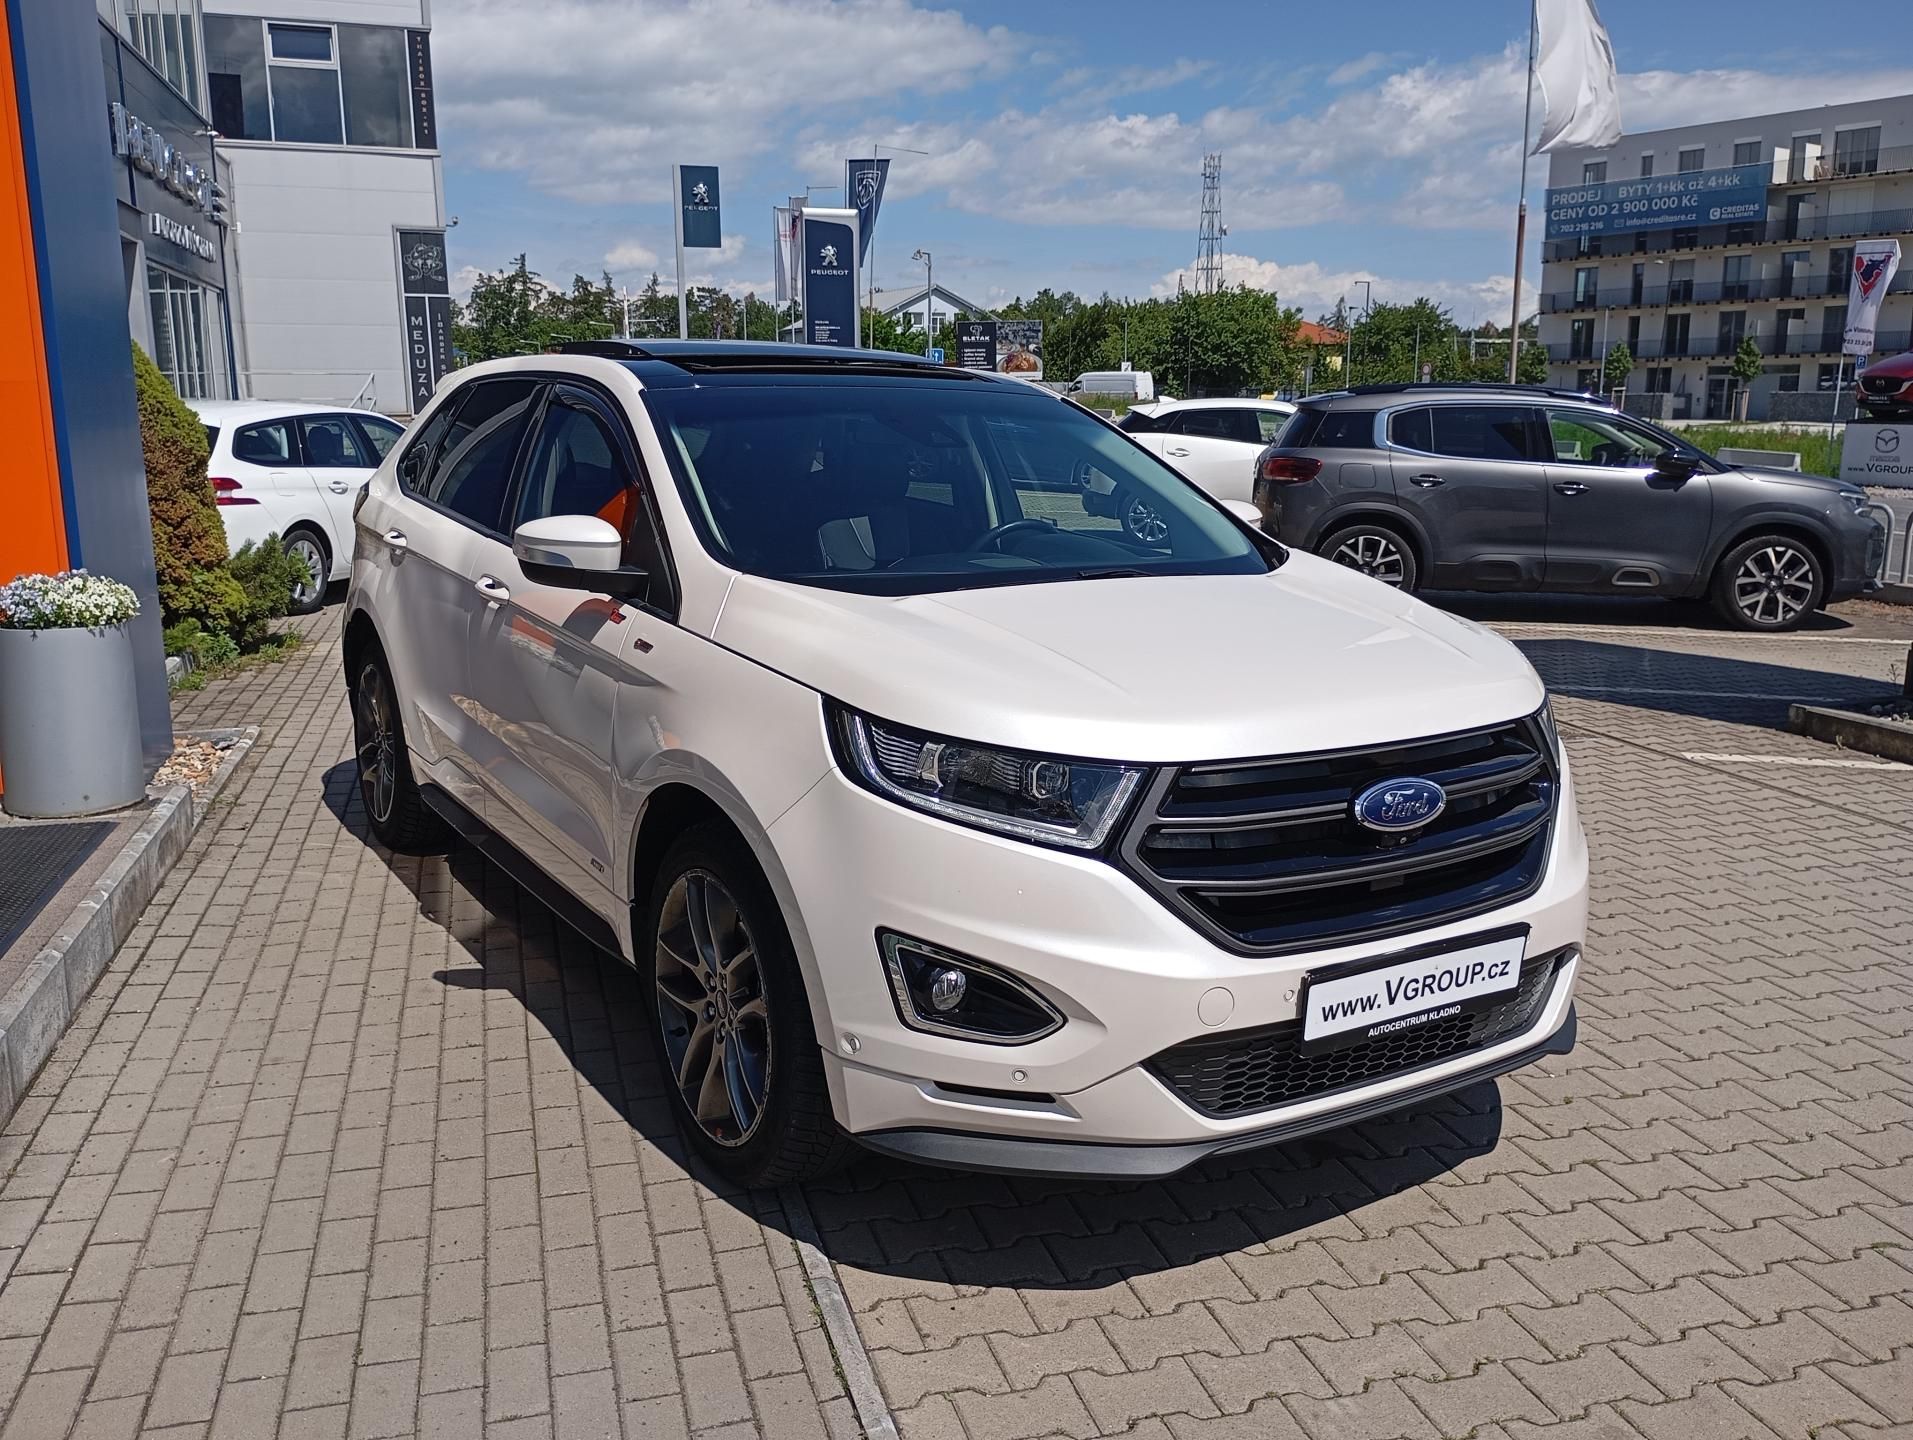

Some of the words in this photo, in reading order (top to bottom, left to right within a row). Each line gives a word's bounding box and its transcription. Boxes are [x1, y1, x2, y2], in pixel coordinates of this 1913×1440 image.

[1551, 207, 1585, 220] CENY
[1588, 205, 1608, 217] OD
[1611, 203, 1619, 215] 2
[1623, 200, 1648, 213] 900
[1652, 196, 1678, 210] 000
[1682, 194, 1698, 208] Kč
[1552, 190, 1601, 206] PRODEJ
[1619, 183, 1653, 198] BYTY
[1656, 180, 1685, 193] 1+kk
[1689, 178, 1704, 190] až
[1708, 174, 1741, 187] 4+kk
[1721, 203, 1760, 214] CREDITAS
[410, 316, 429, 397] MEDUZA
[437, 322, 446, 360] BARBER
[1321, 960, 1511, 1022] www.VGROUP.cz
[1368, 1014, 1428, 1038] AUTOCENTRUM
[1429, 1004, 1461, 1022] KLADNO
